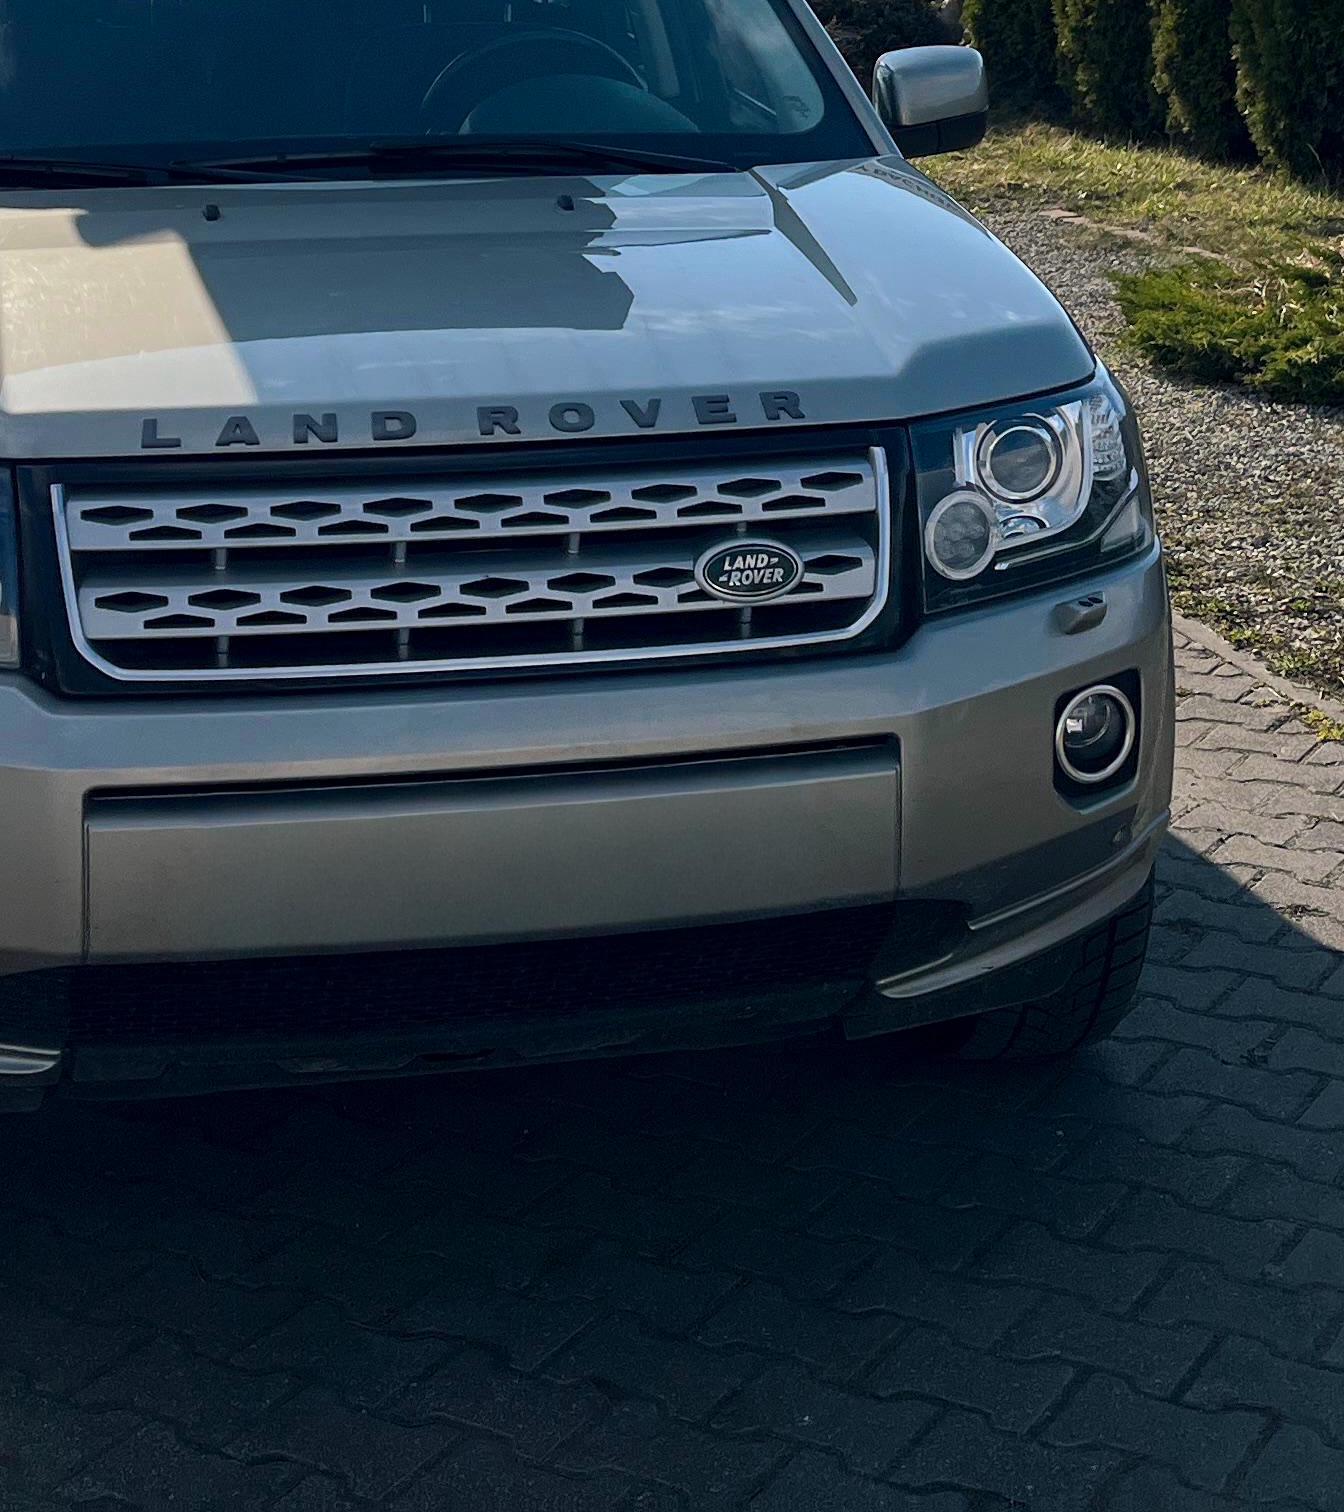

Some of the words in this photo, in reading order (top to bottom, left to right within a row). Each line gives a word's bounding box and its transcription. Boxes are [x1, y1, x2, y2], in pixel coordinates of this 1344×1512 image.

[141, 410, 417, 449] LAND
[476, 390, 805, 435] ROVER
[723, 553, 767, 571] LAND
[728, 568, 785, 587] ROVER
